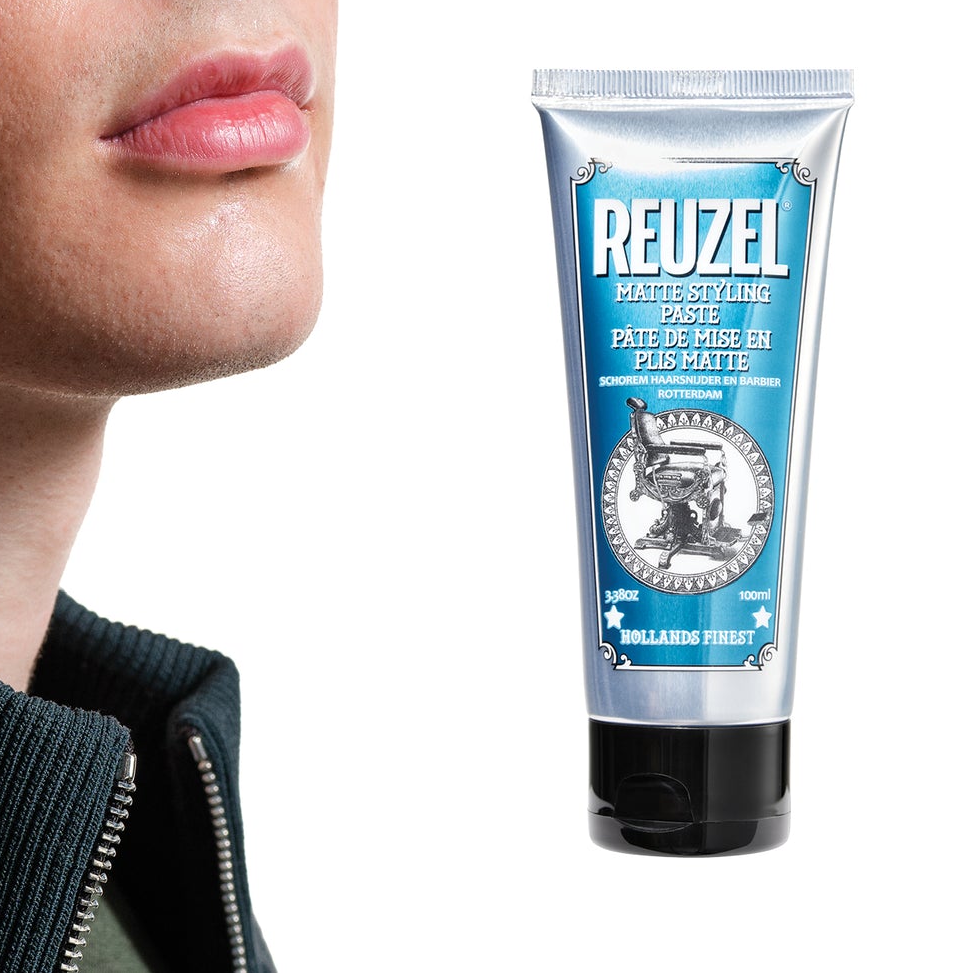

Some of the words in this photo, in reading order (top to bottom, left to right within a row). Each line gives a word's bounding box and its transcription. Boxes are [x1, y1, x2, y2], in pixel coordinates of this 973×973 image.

[593, 198, 790, 279] REUZEL
[615, 282, 683, 303] MATTE
[687, 279, 771, 304] STYLING
[660, 304, 720, 325] PASTE
[611, 325, 659, 349] PÂTE
[664, 329, 689, 349] DE
[694, 329, 742, 349] MISE
[746, 329, 773, 350] EN
[634, 351, 677, 371] PLIS
[682, 352, 750, 372] MATTE
[599, 375, 649, 387] SCHOREM
[724, 376, 738, 386] EN
[740, 377, 781, 387] BARBIER
[658, 389, 723, 400] ROTTERDAM
[739, 588, 771, 600] 100ml
[620, 629, 701, 646] HOLLANDS
[703, 629, 756, 645] FINEST
